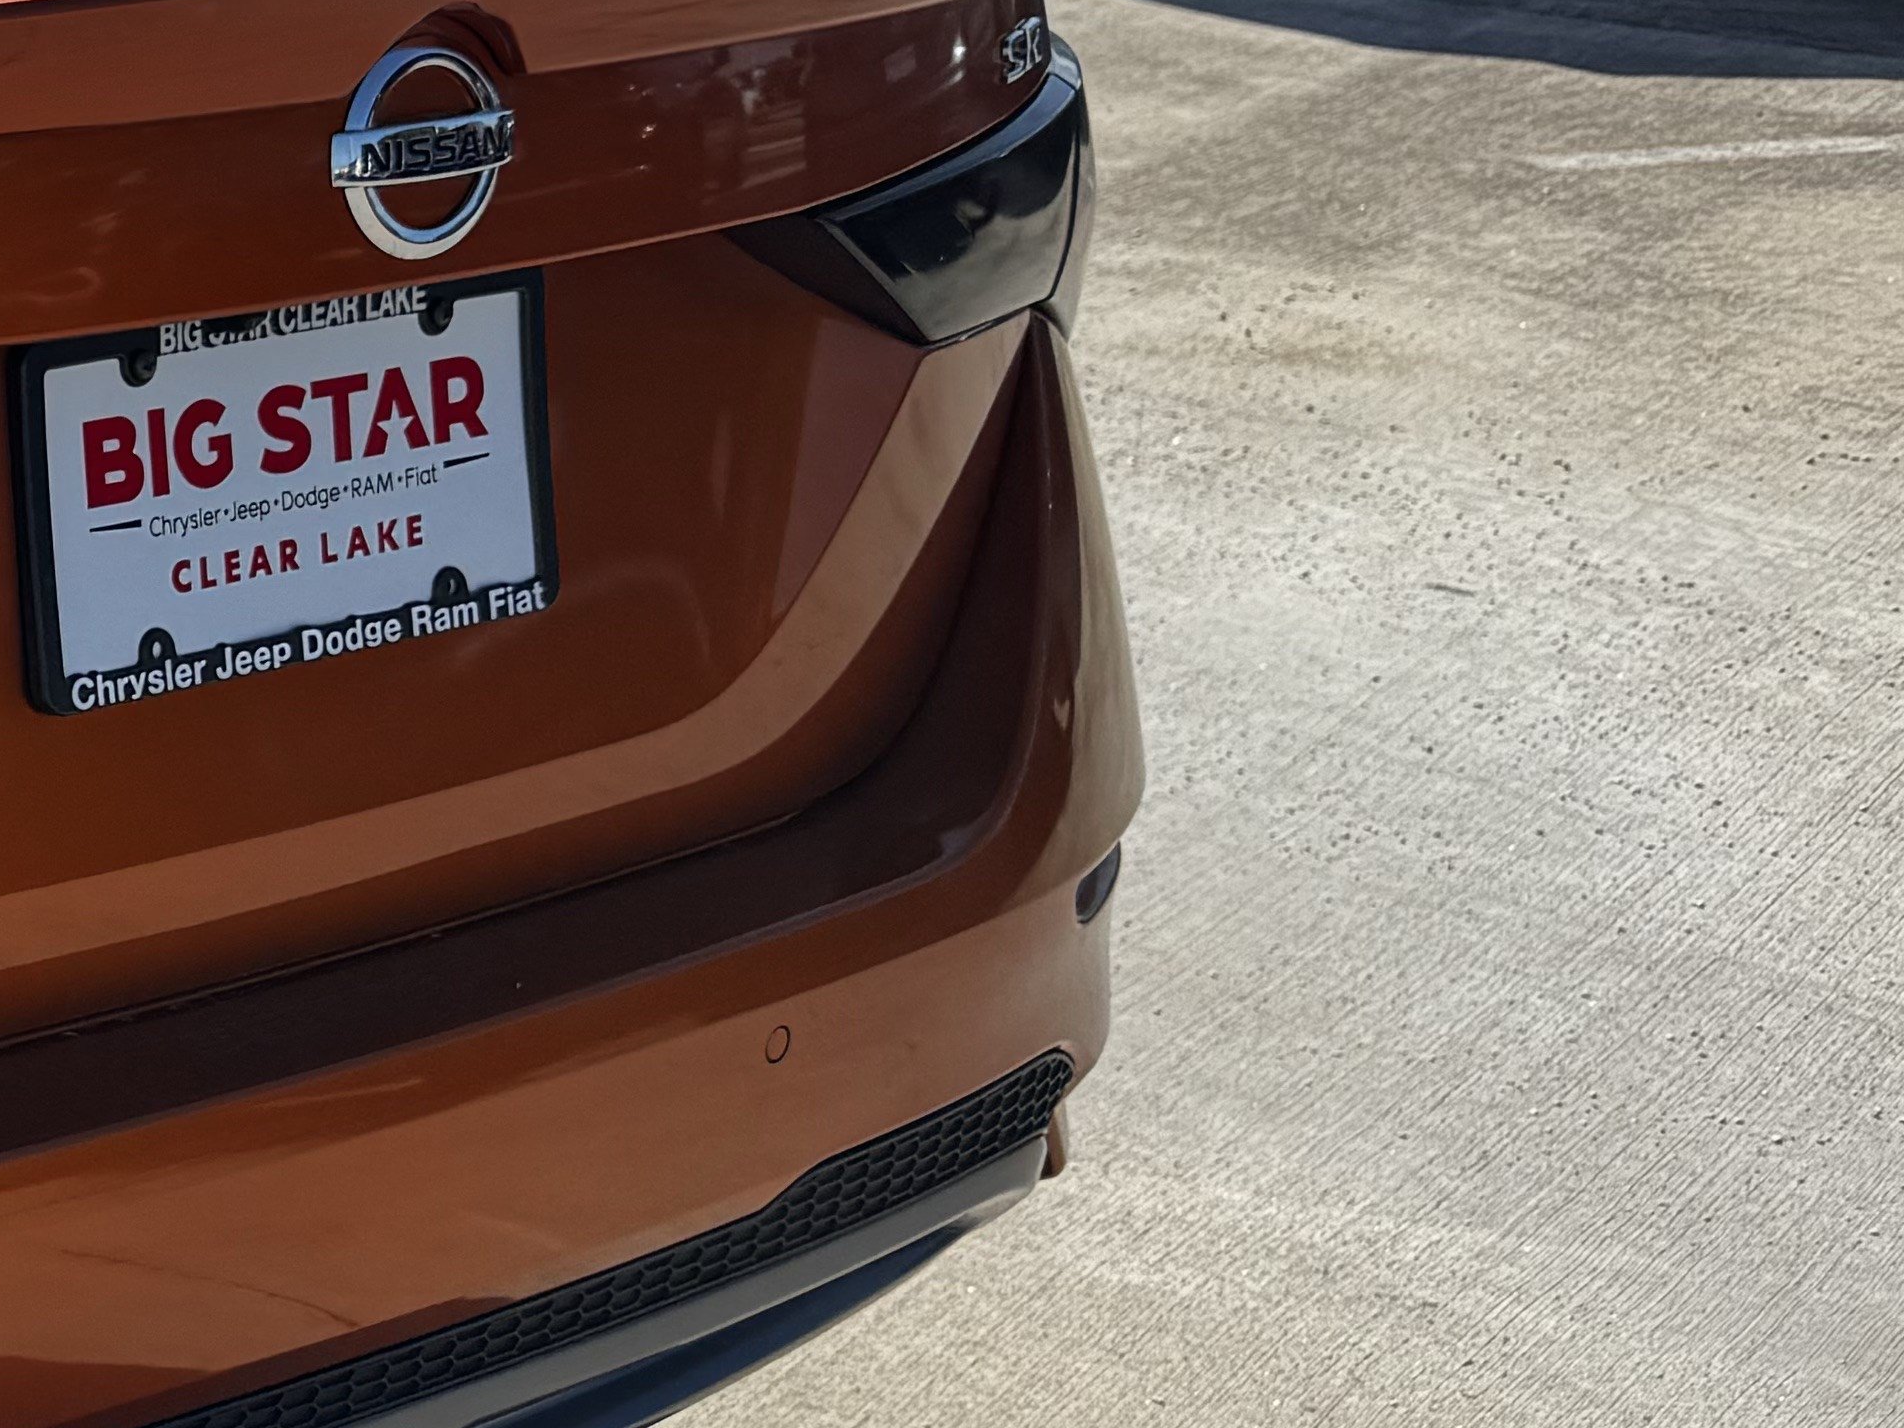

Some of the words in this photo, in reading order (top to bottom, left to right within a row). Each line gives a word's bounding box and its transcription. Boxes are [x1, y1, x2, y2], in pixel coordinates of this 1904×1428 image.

[360, 114, 512, 176] NISSAN
[158, 319, 202, 355] BIG
[278, 294, 360, 334] CLEAR
[365, 284, 428, 320] LAKE
[82, 398, 234, 509] BIG
[257, 356, 489, 474] STAR
[171, 538, 300, 594] CLEAR
[320, 514, 424, 565] LAKE
[71, 657, 207, 711] Chrysler
[216, 639, 292, 681] Jeep
[301, 617, 403, 662] Dodge
[411, 598, 480, 637] Ram
[488, 581, 547, 621] Fiat
